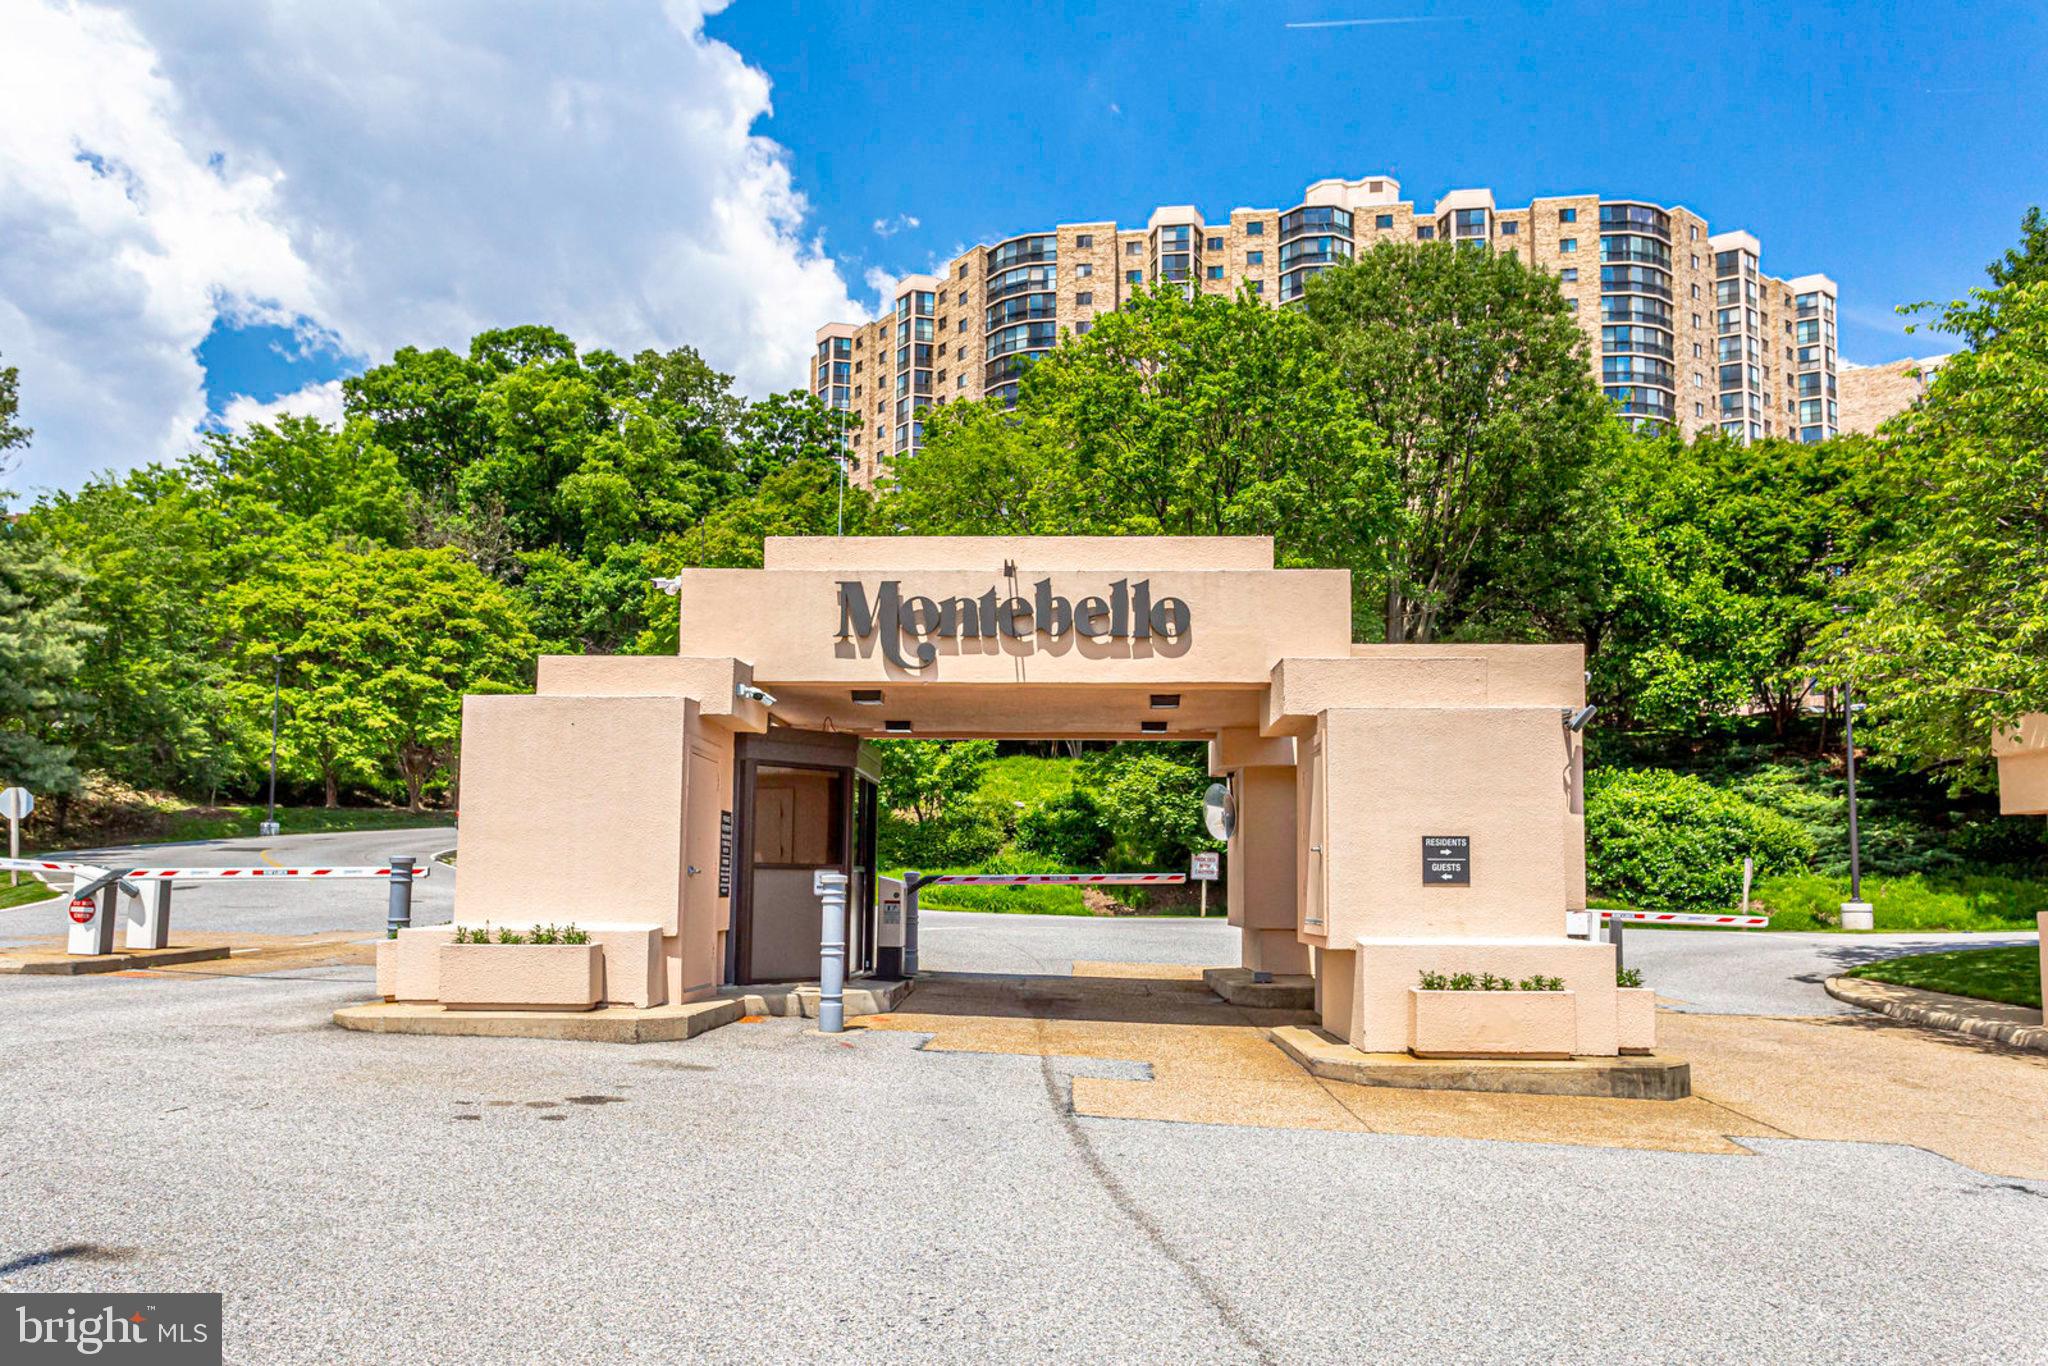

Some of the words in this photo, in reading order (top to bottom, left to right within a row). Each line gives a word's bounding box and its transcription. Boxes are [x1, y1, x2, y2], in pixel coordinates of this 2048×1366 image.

[833, 578, 1191, 669] Montebello
[1425, 838, 1468, 847] RESIDENTS
[1431, 863, 1462, 872] GUESTS
